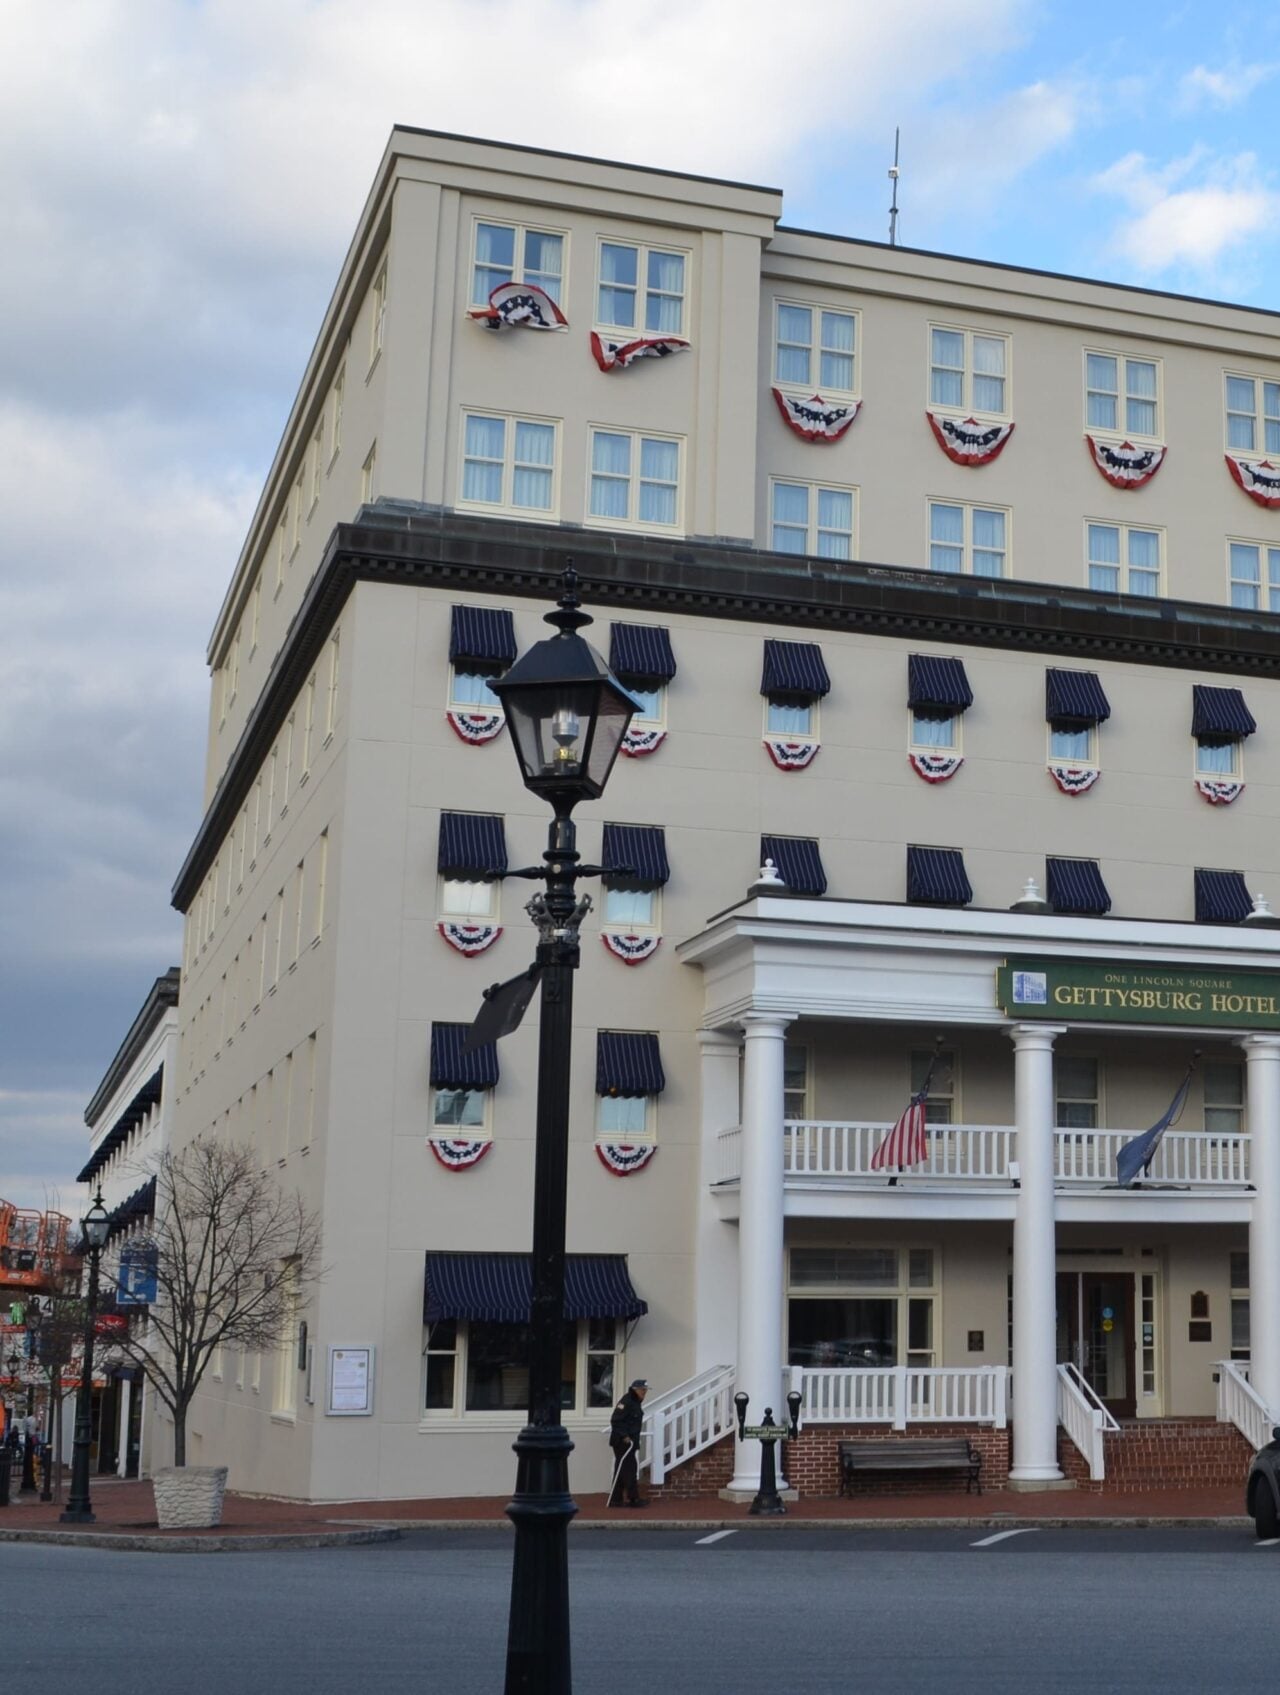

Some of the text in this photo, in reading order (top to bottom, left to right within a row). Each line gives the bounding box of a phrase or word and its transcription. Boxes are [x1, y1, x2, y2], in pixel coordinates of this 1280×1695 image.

[1104, 974, 1232, 989] ONE LINCOLN SQUARE
[1054, 986, 1280, 1014] GETTYSBURG HOTEL
